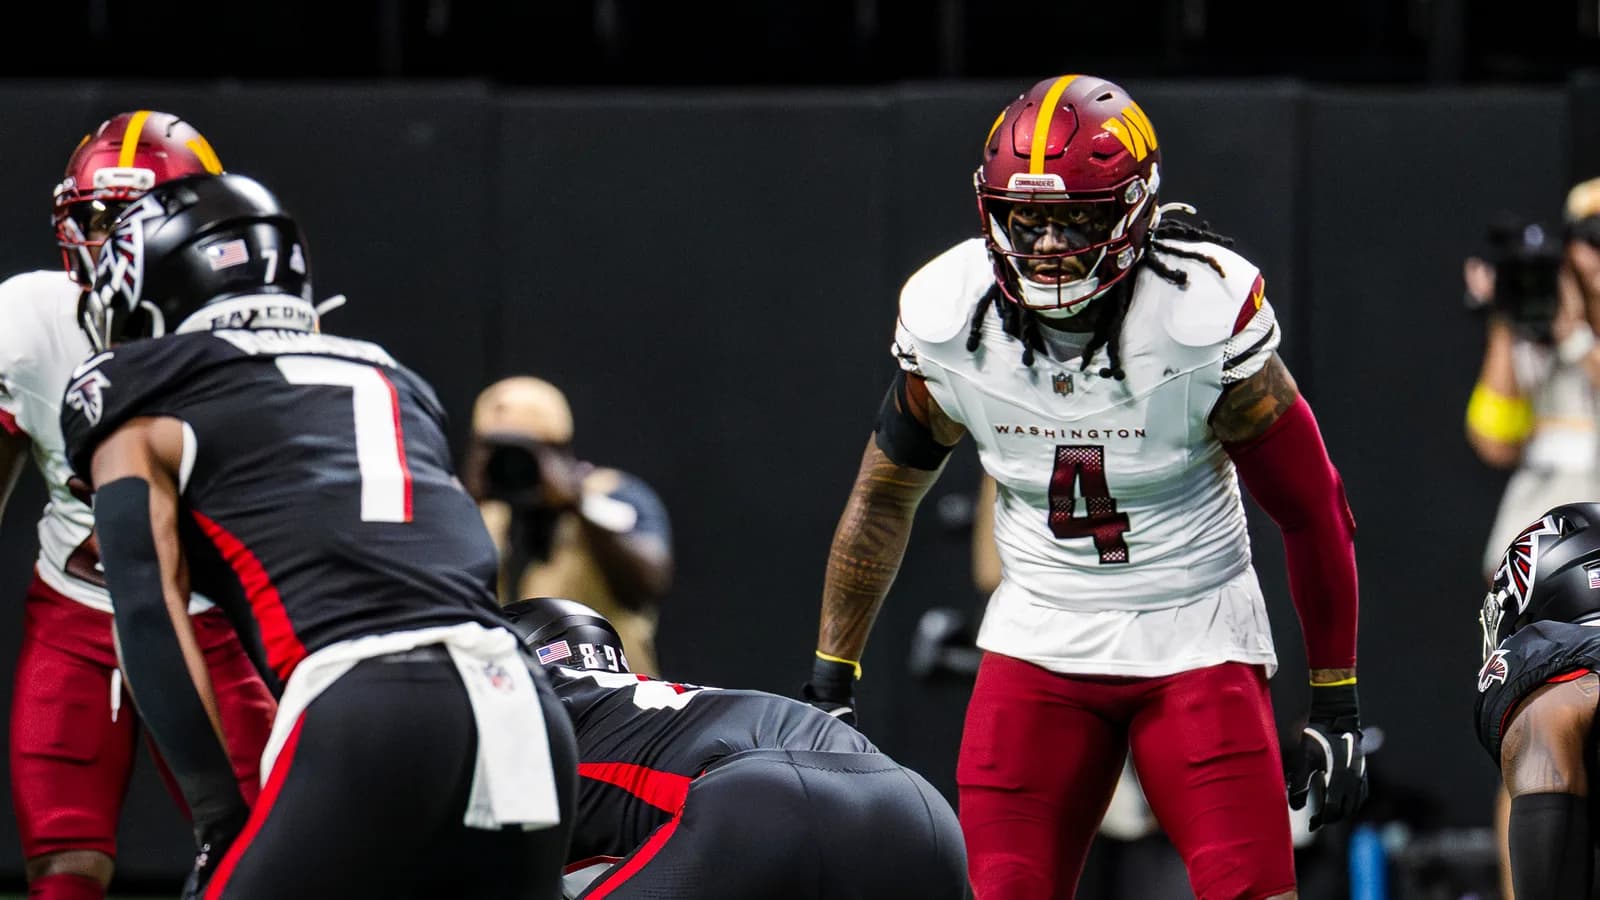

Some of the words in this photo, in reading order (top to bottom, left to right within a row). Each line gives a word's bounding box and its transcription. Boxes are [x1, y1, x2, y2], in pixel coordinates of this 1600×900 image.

[1014, 179, 1055, 187] COMMANDERS
[261, 249, 278, 284] 7
[275, 353, 413, 523] 7
[995, 425, 1147, 439] WASHINGTON
[1048, 444, 1131, 564] 4
